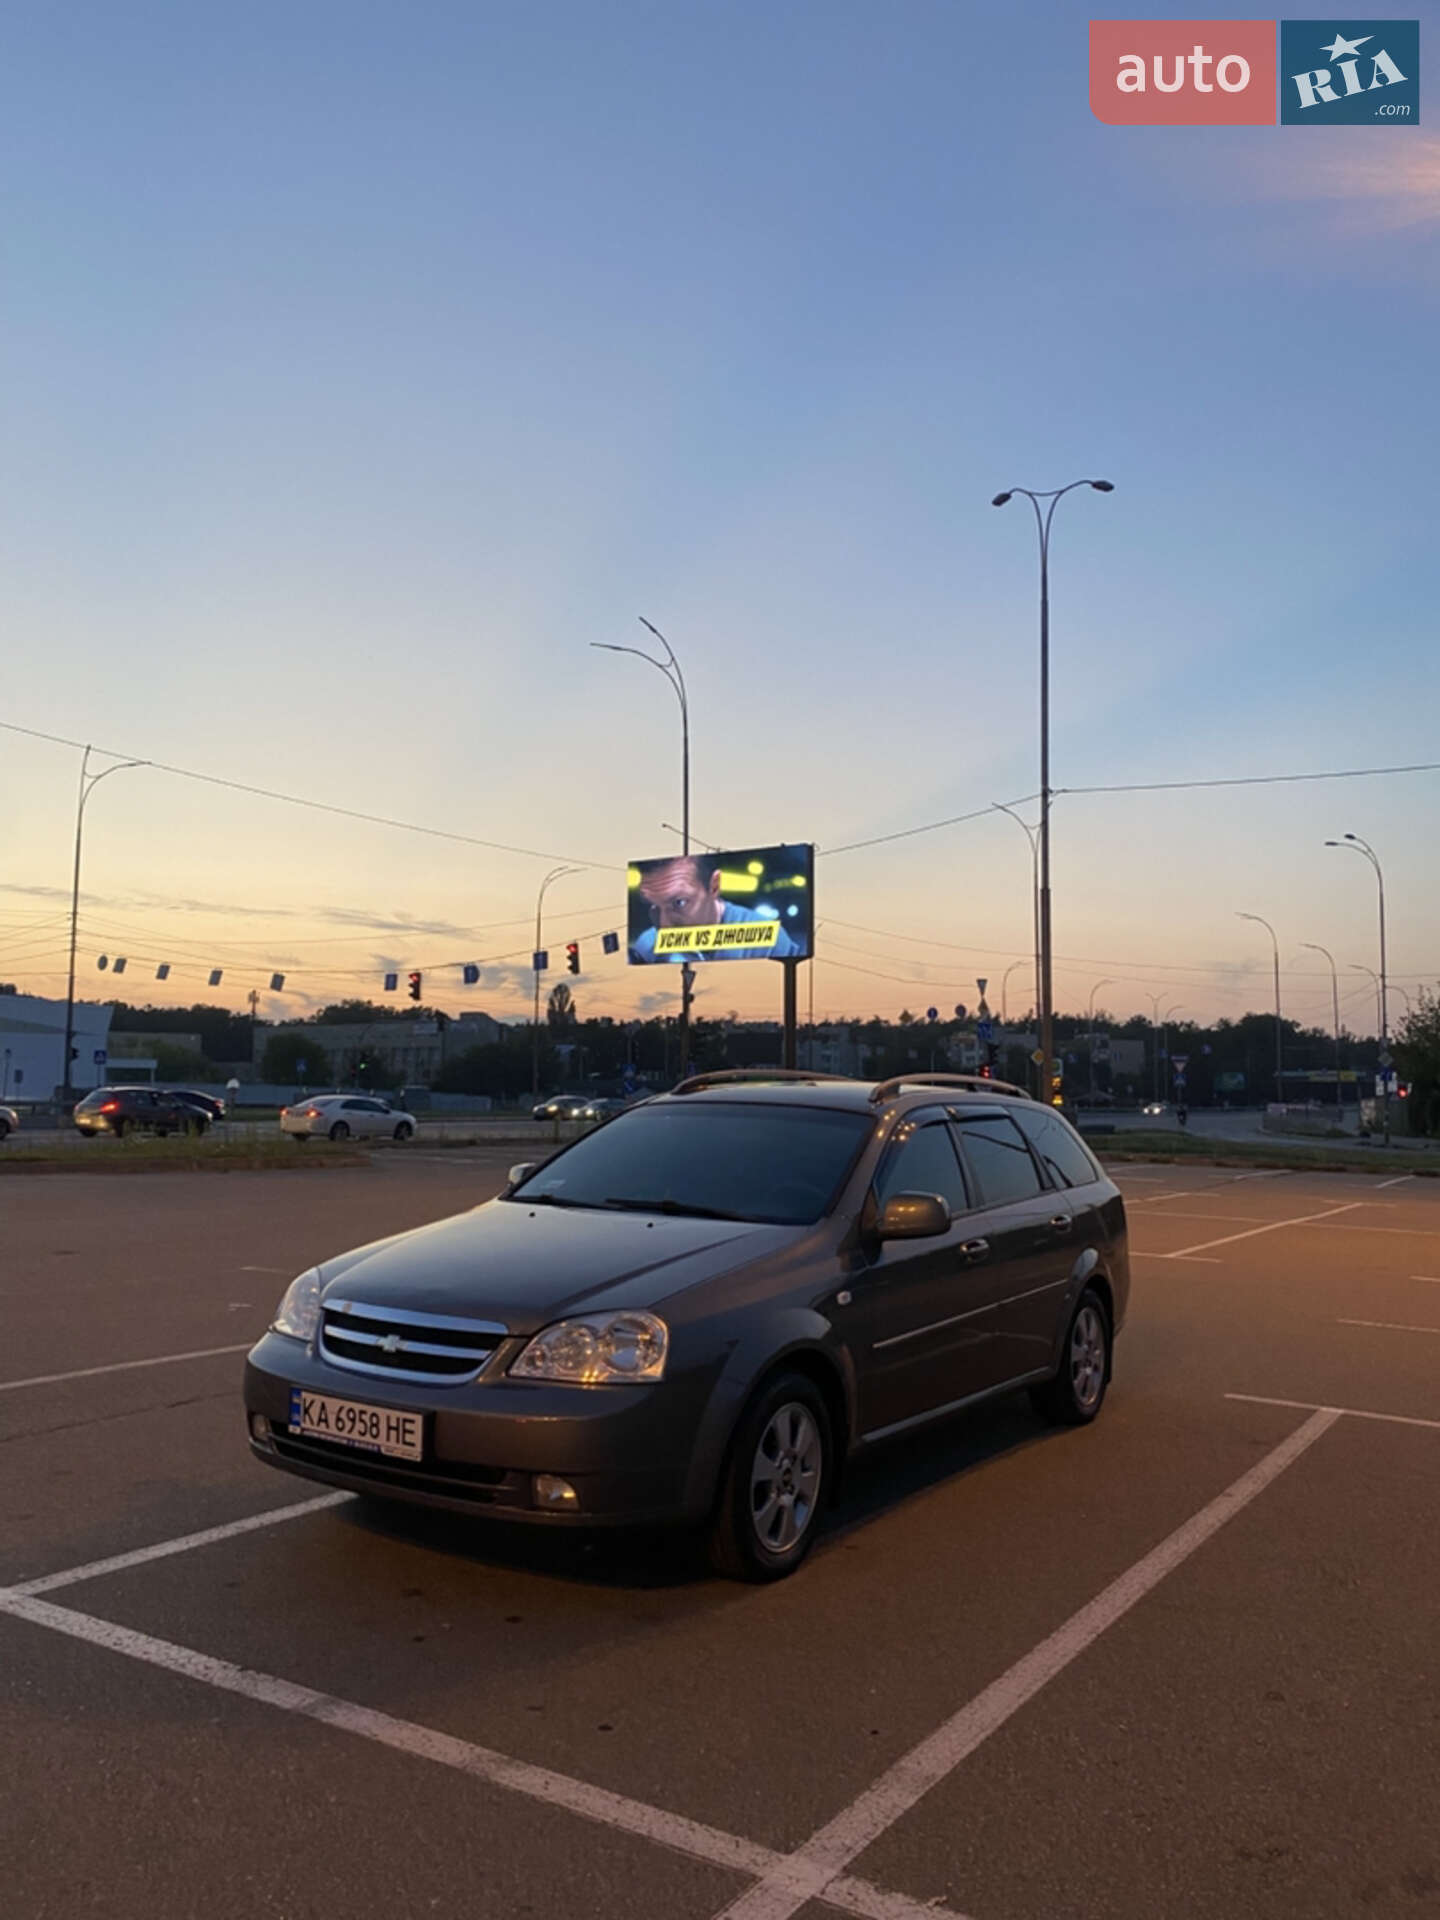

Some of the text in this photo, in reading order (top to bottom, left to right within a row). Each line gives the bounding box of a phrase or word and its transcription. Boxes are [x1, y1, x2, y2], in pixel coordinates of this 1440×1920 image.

[659, 926, 773, 948] УСИК VS ДЖОШУА
[303, 1398, 330, 1430] KA
[335, 1405, 380, 1439] 6958
[386, 1415, 416, 1447] HE
